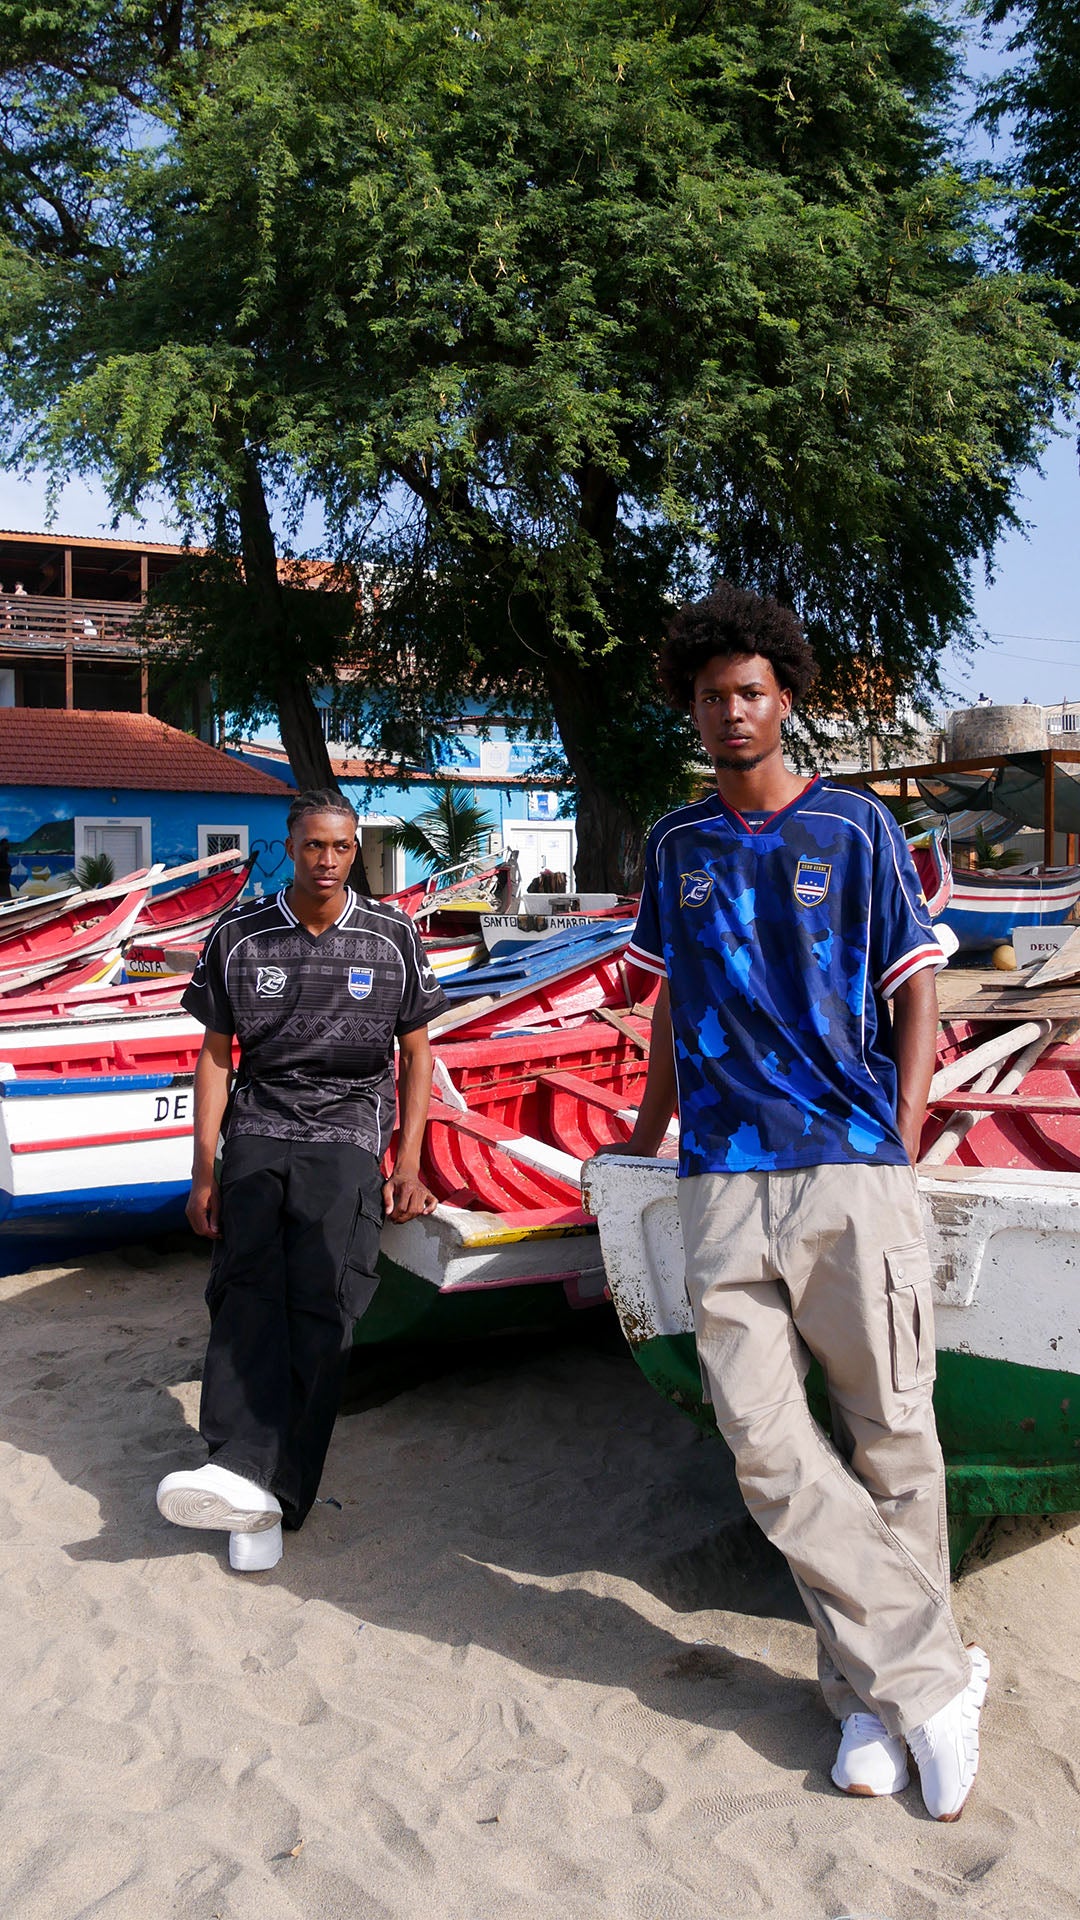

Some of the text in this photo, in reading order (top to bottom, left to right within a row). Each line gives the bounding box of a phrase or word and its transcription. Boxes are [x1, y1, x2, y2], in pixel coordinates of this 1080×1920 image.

[483, 916, 517, 928] SANTO
[1030, 943, 1059, 951] DEUS
[129, 960, 163, 973] COSTA
[154, 1094, 188, 1122] DE
